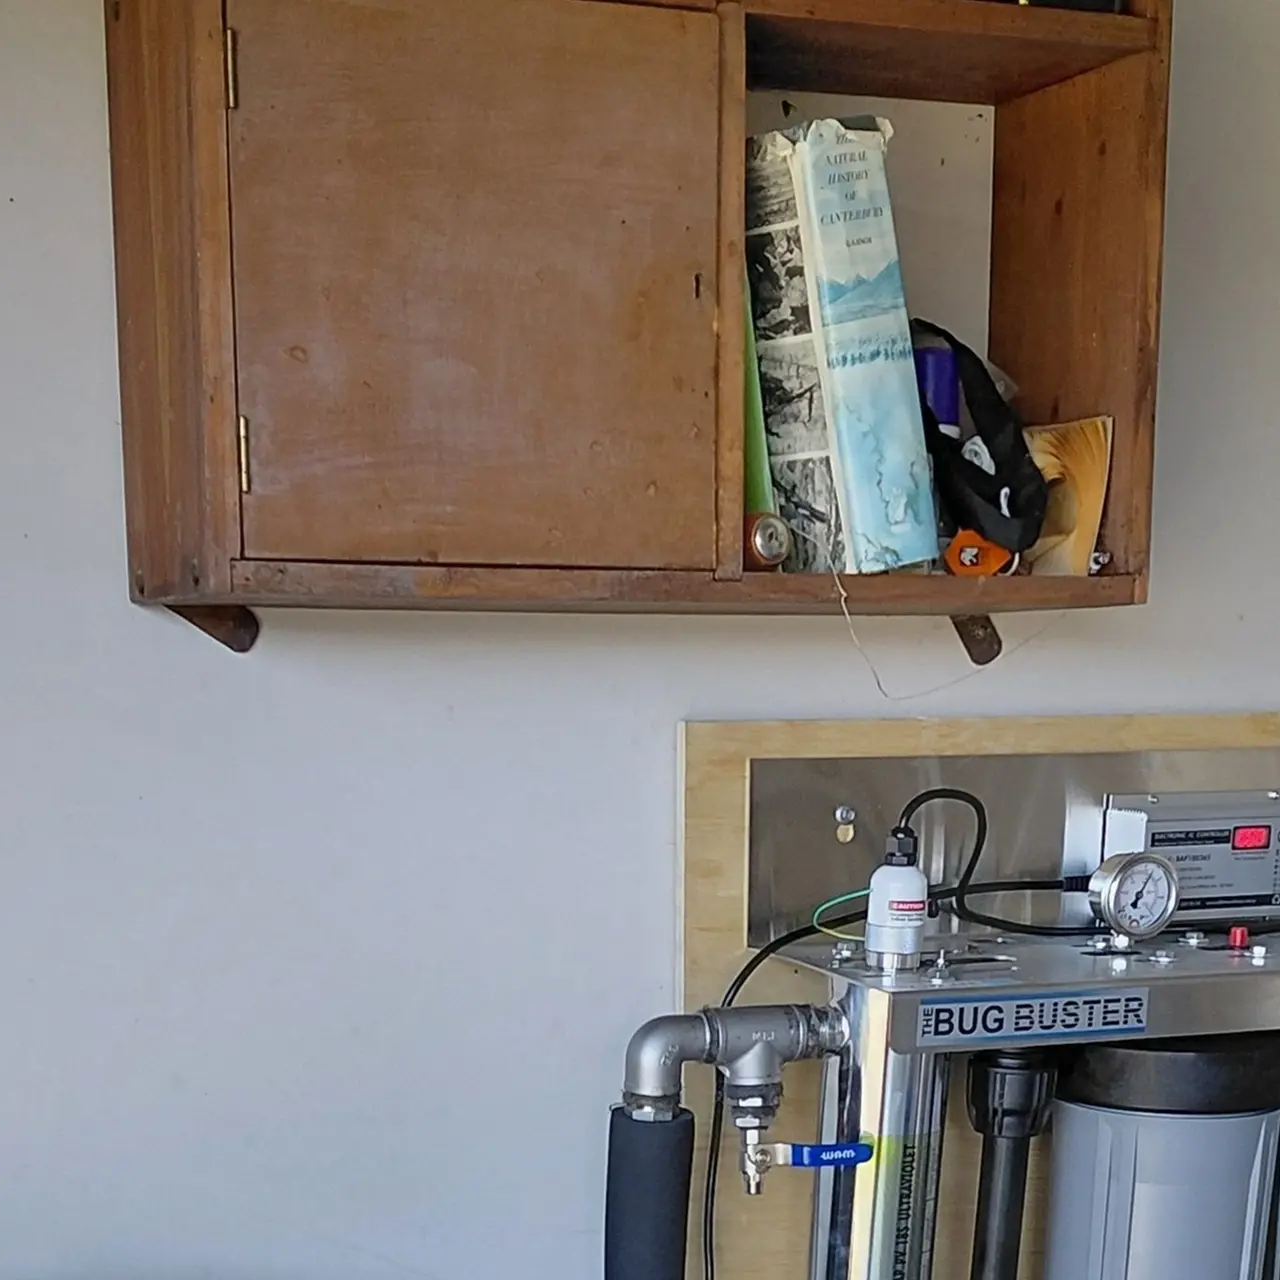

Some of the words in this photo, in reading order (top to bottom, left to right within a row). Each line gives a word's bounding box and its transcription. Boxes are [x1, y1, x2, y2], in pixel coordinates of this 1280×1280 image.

[828, 169, 870, 185] HISTORY
[921, 1007, 934, 1037] THE
[933, 1004, 1004, 1037] BUG
[1013, 996, 1144, 1032] BUSTER
[897, 1143, 916, 1221] ULTRAVIOLET
